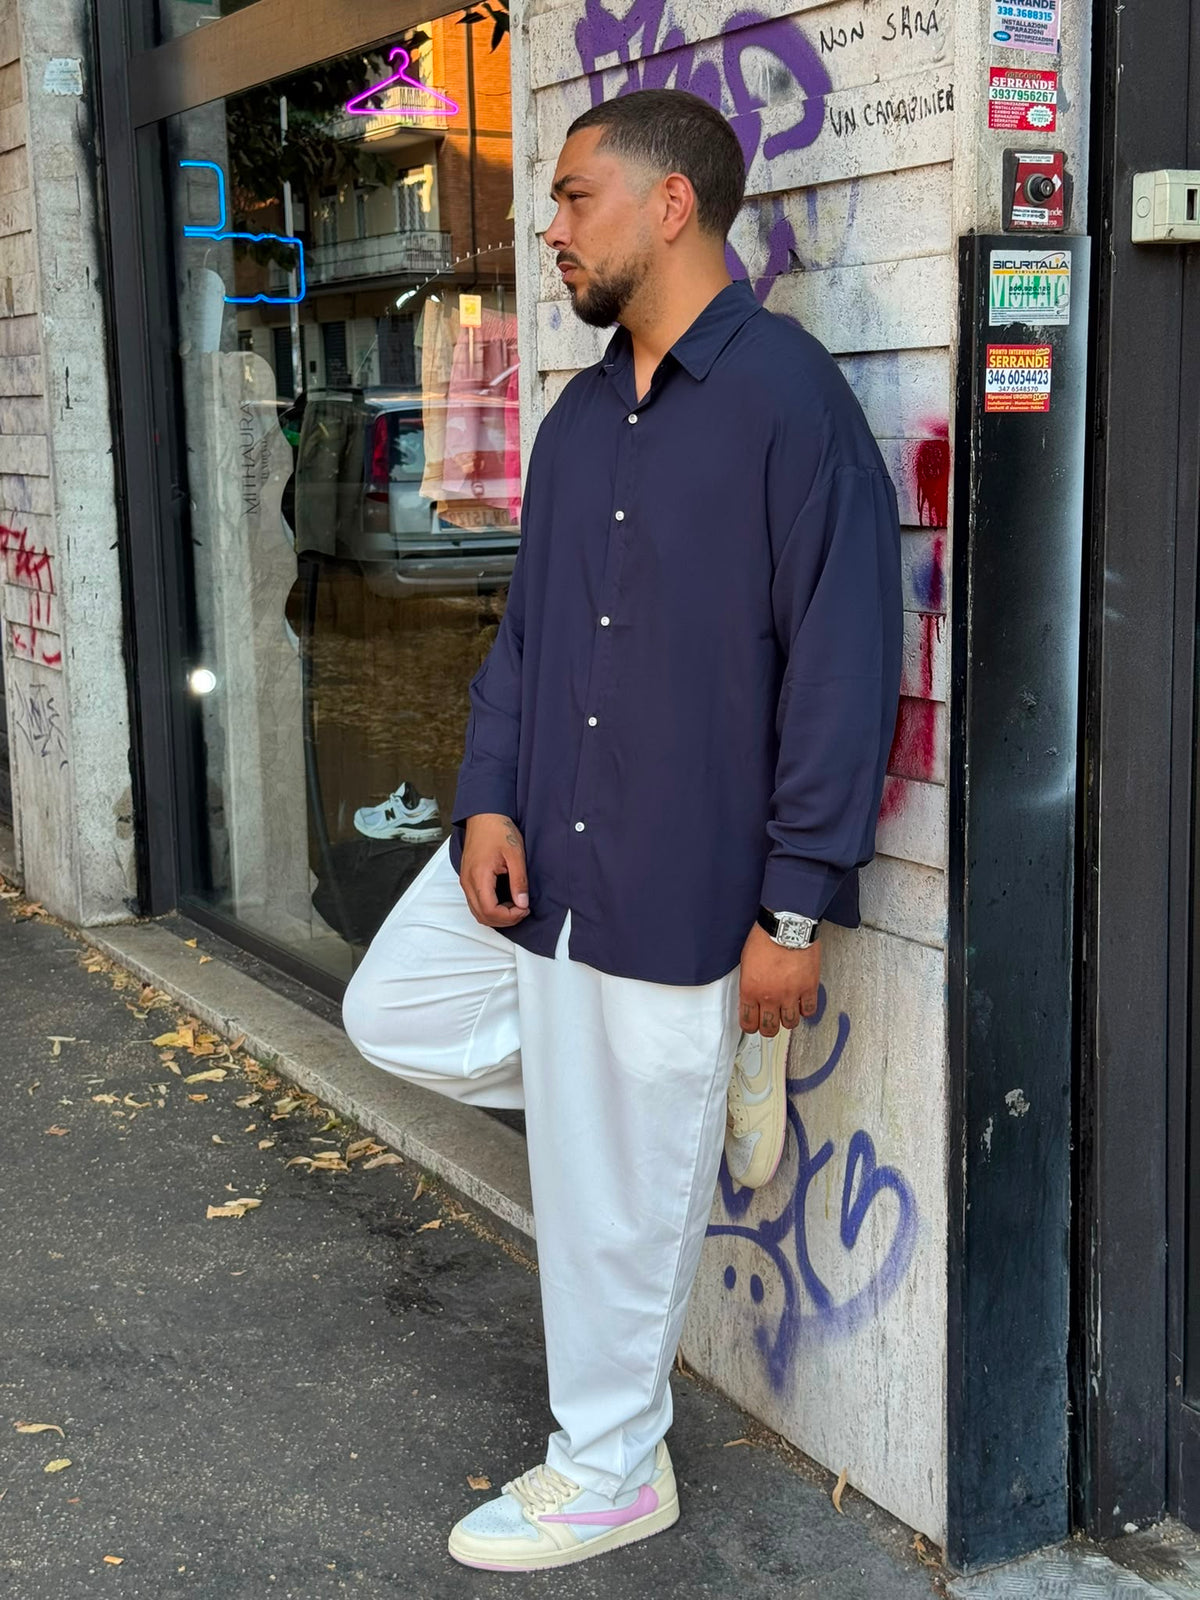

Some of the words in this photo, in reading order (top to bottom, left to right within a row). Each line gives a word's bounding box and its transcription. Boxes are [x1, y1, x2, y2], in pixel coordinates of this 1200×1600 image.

[997, 6, 1053, 22] 338.3688315
[820, 21, 864, 53] NON
[992, 76, 1055, 90] SERRANDE
[991, 88, 1055, 103] 3937956267
[830, 107, 856, 138] UN
[992, 258, 1070, 270] SICURITALIA
[991, 275, 1070, 307] VIGILATO
[989, 355, 1050, 368] SERRANDE
[988, 369, 1006, 385] 346
[1007, 369, 1049, 385] 6054423
[240, 400, 260, 518] MITHAURA
[384, 807, 397, 821] N
